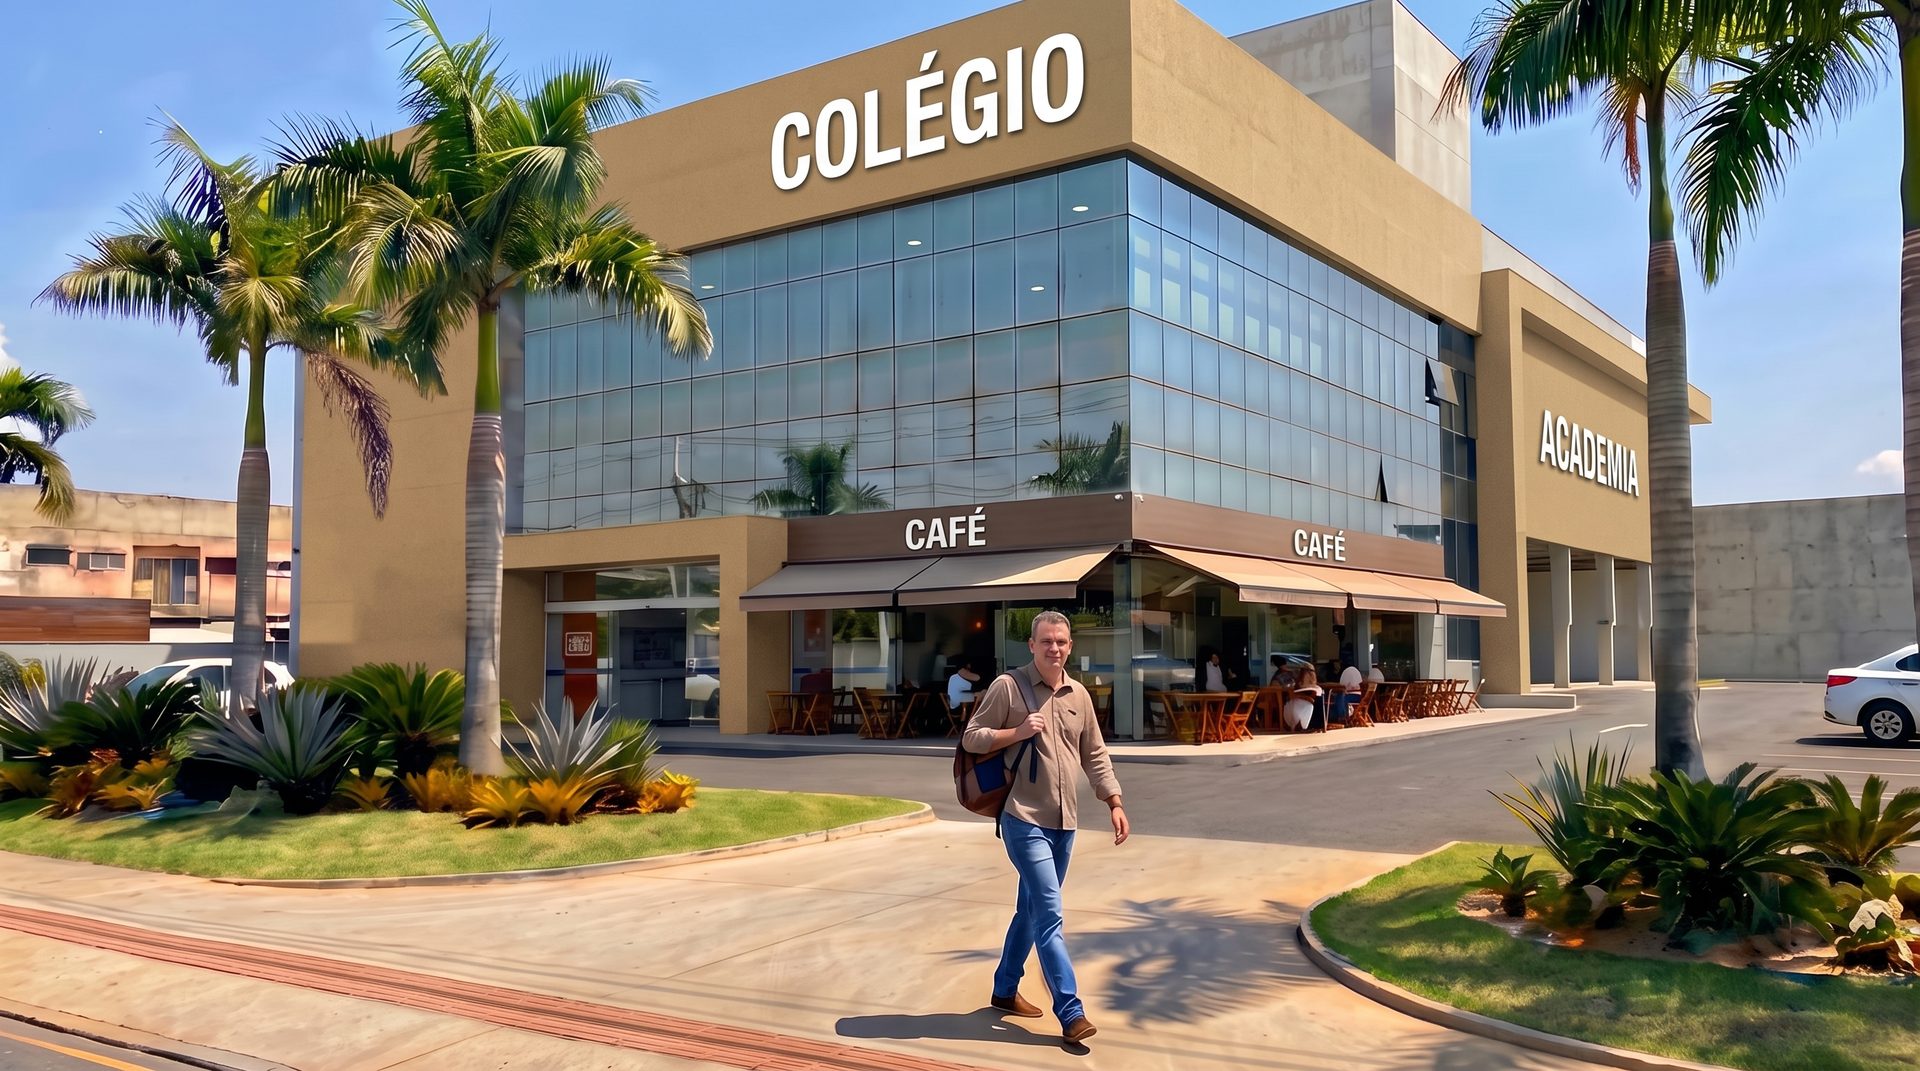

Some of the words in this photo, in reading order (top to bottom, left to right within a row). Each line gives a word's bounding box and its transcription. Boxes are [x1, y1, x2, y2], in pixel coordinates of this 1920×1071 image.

[771, 32, 1085, 190] COLÉGIO
[1540, 409, 1639, 497] ACADEMIA
[905, 506, 986, 550] CAFÉ
[1294, 529, 1346, 562] CAFÉ
